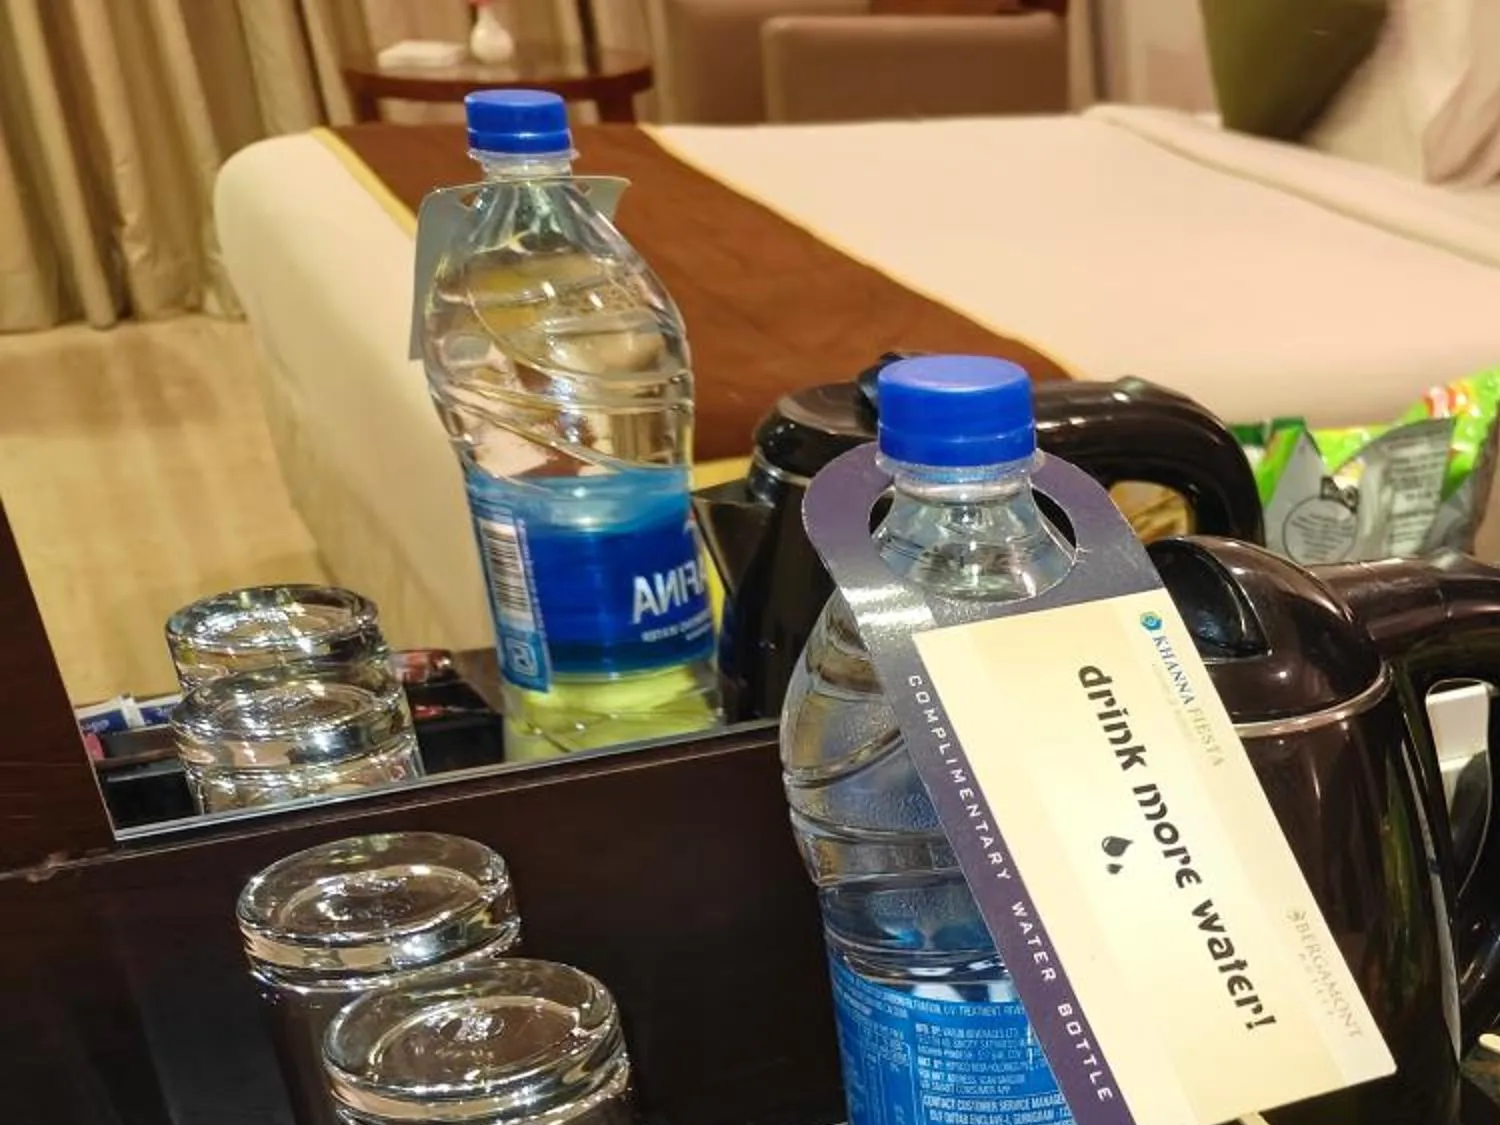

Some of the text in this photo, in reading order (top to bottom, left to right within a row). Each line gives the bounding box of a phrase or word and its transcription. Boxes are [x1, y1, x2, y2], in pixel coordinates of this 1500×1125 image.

[1079, 665, 1148, 772] drink
[1133, 783, 1203, 890] more
[1192, 898, 1277, 1032] water!
[1152, 635, 1195, 705] KHANNA
[907, 674, 1011, 881] COMPLIMENTARY
[1011, 901, 1057, 983] WATER
[1058, 1002, 1113, 1103] BOTTLE
